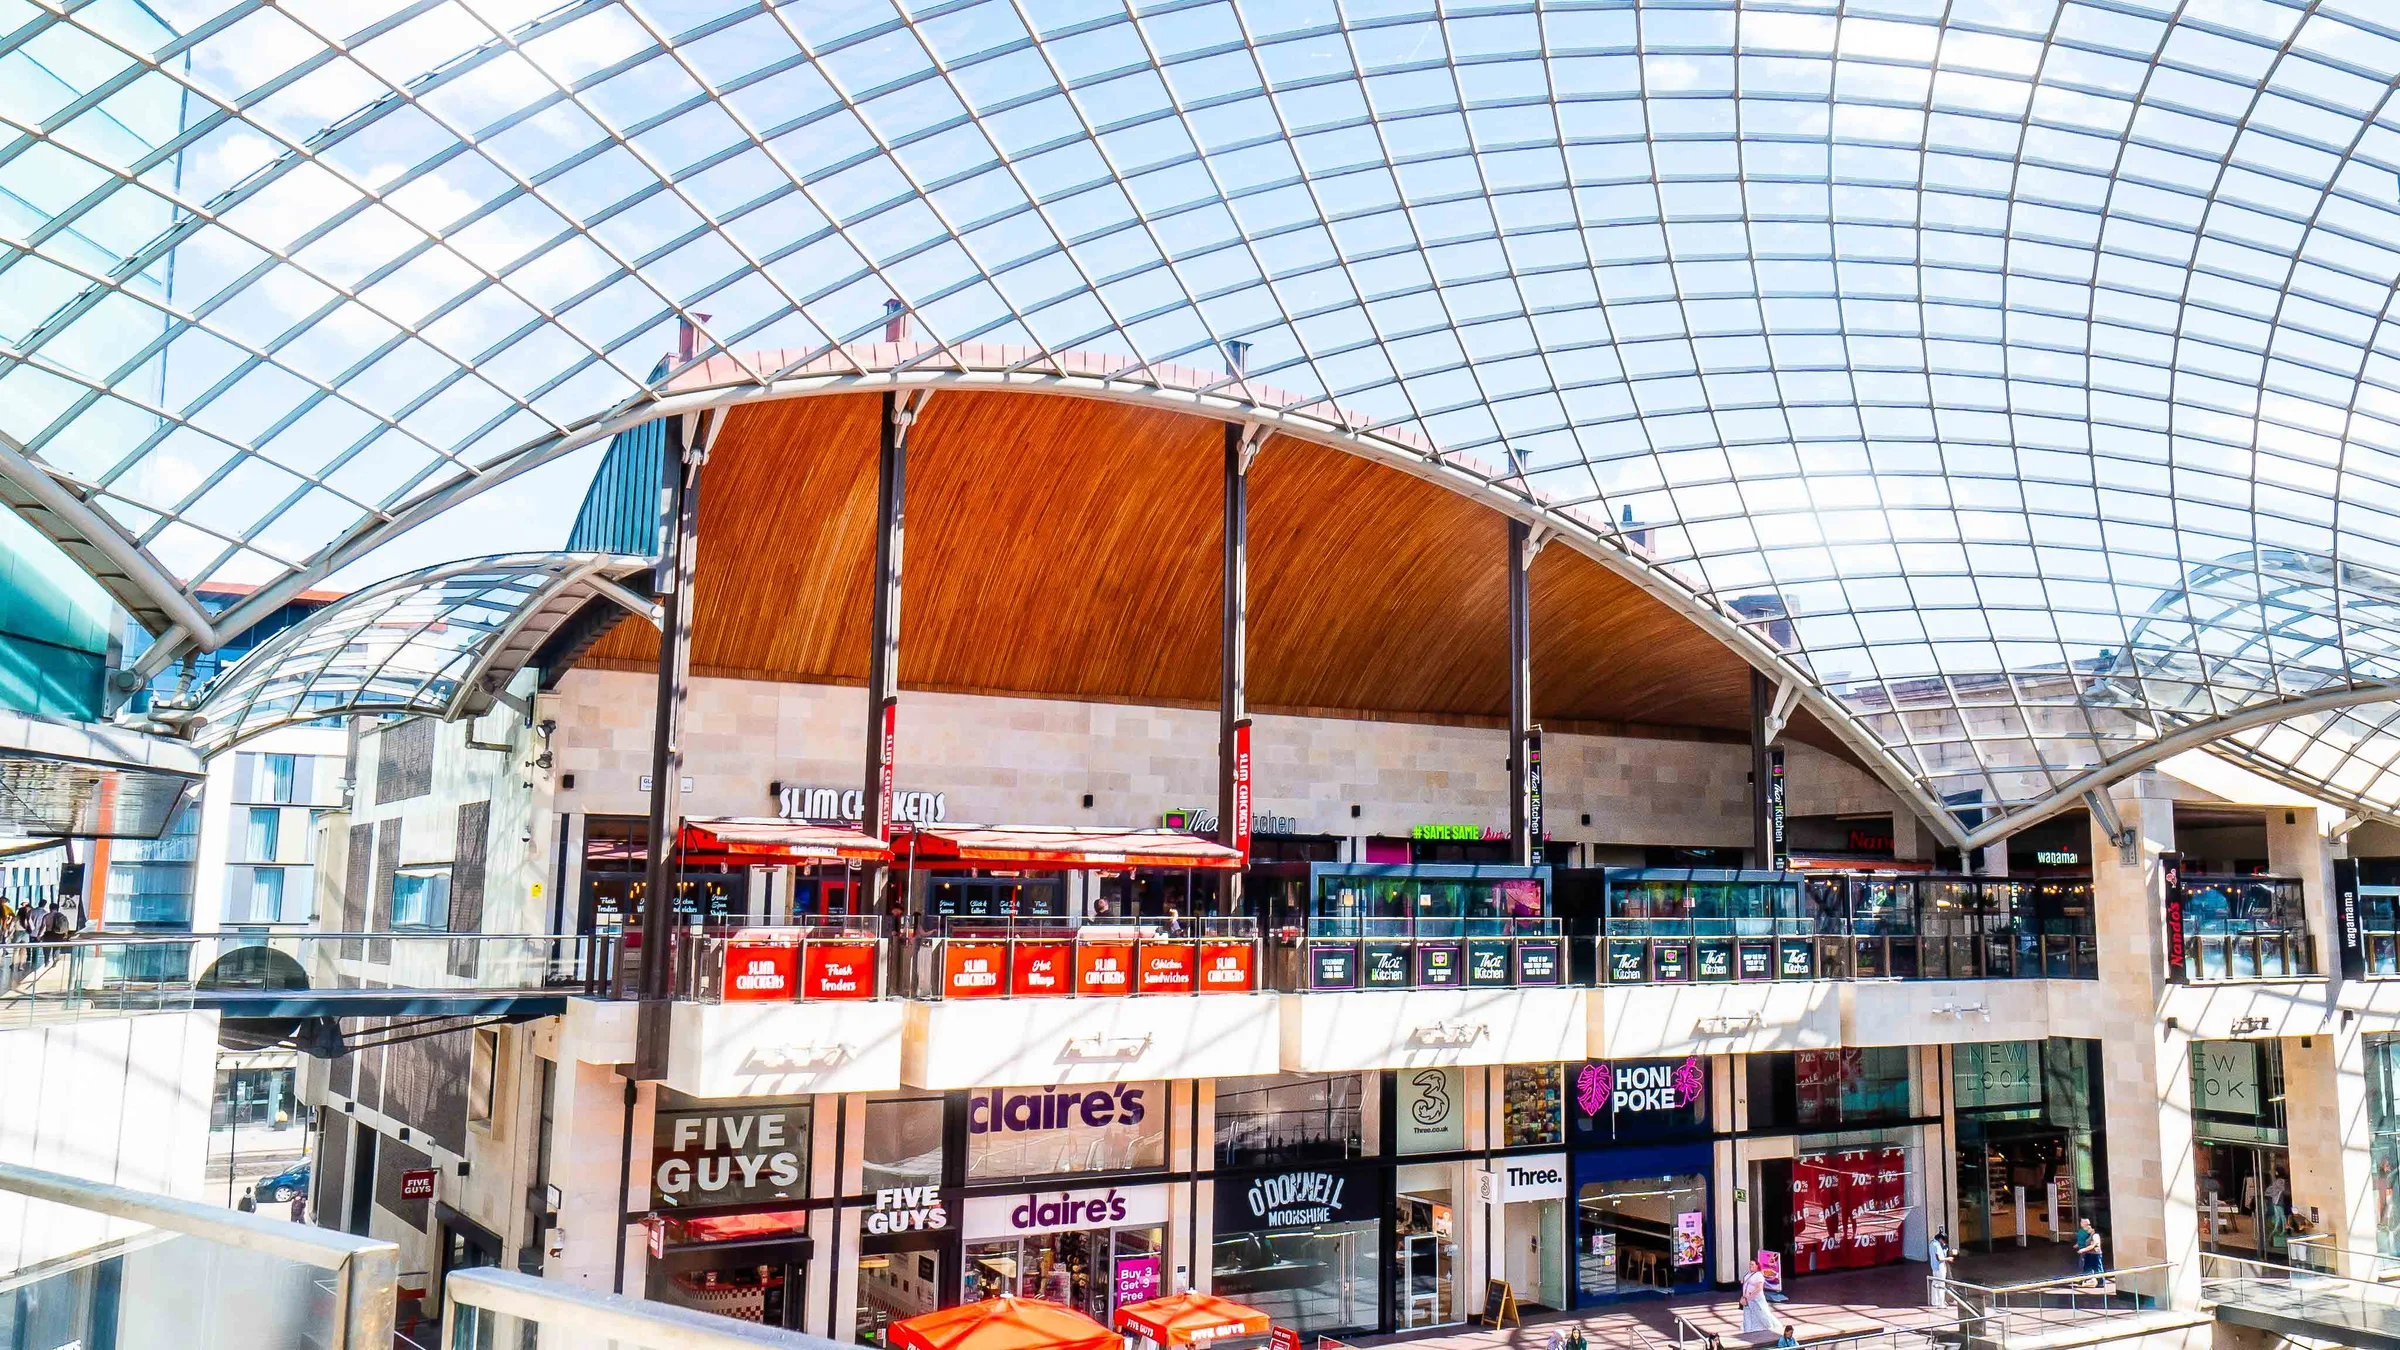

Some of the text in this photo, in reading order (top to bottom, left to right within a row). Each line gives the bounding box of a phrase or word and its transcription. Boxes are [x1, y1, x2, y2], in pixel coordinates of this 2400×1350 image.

[883, 769, 891, 826] CHICKENS
[1239, 753, 1248, 836] SLIM CHICKENS
[779, 787, 946, 822] SLIM CHKENS
[1177, 808, 1296, 834] Tha tchen
[1532, 799, 1540, 834] Kitchen
[1452, 826, 1479, 840] SAME
[1775, 808, 1784, 842] Kitchen
[2344, 891, 2357, 947] wagamama
[2169, 902, 2183, 967] Nando's
[748, 960, 775, 975] SLIM
[825, 963, 852, 976] Fresh
[964, 959, 987, 973] SLIM
[1032, 959, 1051, 971] Hot
[1095, 958, 1117, 971] SLIM
[1151, 958, 1183, 970] Chicken
[1217, 957, 1236, 970] SLIM
[1705, 963, 1726, 974] Kitchen
[1787, 963, 1808, 973] Kitchen
[954, 973, 996, 986] CHICKENS
[1028, 973, 1054, 987] Wings
[1085, 971, 1125, 984] CHICKENS
[1144, 972, 1189, 984] Sandwiches
[1208, 970, 1245, 982] CHICKENS
[1375, 968, 1402, 980] Kitchen
[1478, 967, 1504, 978] Kitchen
[1617, 968, 1640, 979] Kitchen
[736, 975, 784, 989] CHICKENS
[821, 978, 856, 991] Tenders
[1969, 1044, 2025, 1064] NEW
[1616, 1066, 1671, 1090] HONI
[1966, 1070, 2031, 1090] LOOK
[1412, 1069, 1450, 1125] 3
[1613, 1088, 1676, 1112] POKE
[970, 1083, 1145, 1134] claire's
[674, 1114, 785, 1151] FIVE
[657, 1152, 798, 1193] GUYS
[1507, 1167, 1562, 1186] Three.
[404, 1186, 431, 1194] GUYS
[407, 1178, 430, 1187] FIVE
[876, 1185, 942, 1210] FIVE
[1248, 1172, 1344, 1216] O'DONNELL
[1012, 1189, 1126, 1229] claire's
[1268, 1207, 1331, 1227] MOONSHINE
[1818, 1202, 1840, 1223] SALE
[1852, 1199, 1875, 1219] SALE
[867, 1207, 947, 1234] GUYS
[1121, 1267, 1152, 1281] Buy 3
[1121, 1280, 1139, 1291] Get
[1120, 1292, 1144, 1302] Free
[1126, 1319, 1154, 1337] FIVE GUYS
[1190, 1323, 1246, 1341] FIVE GUYS
